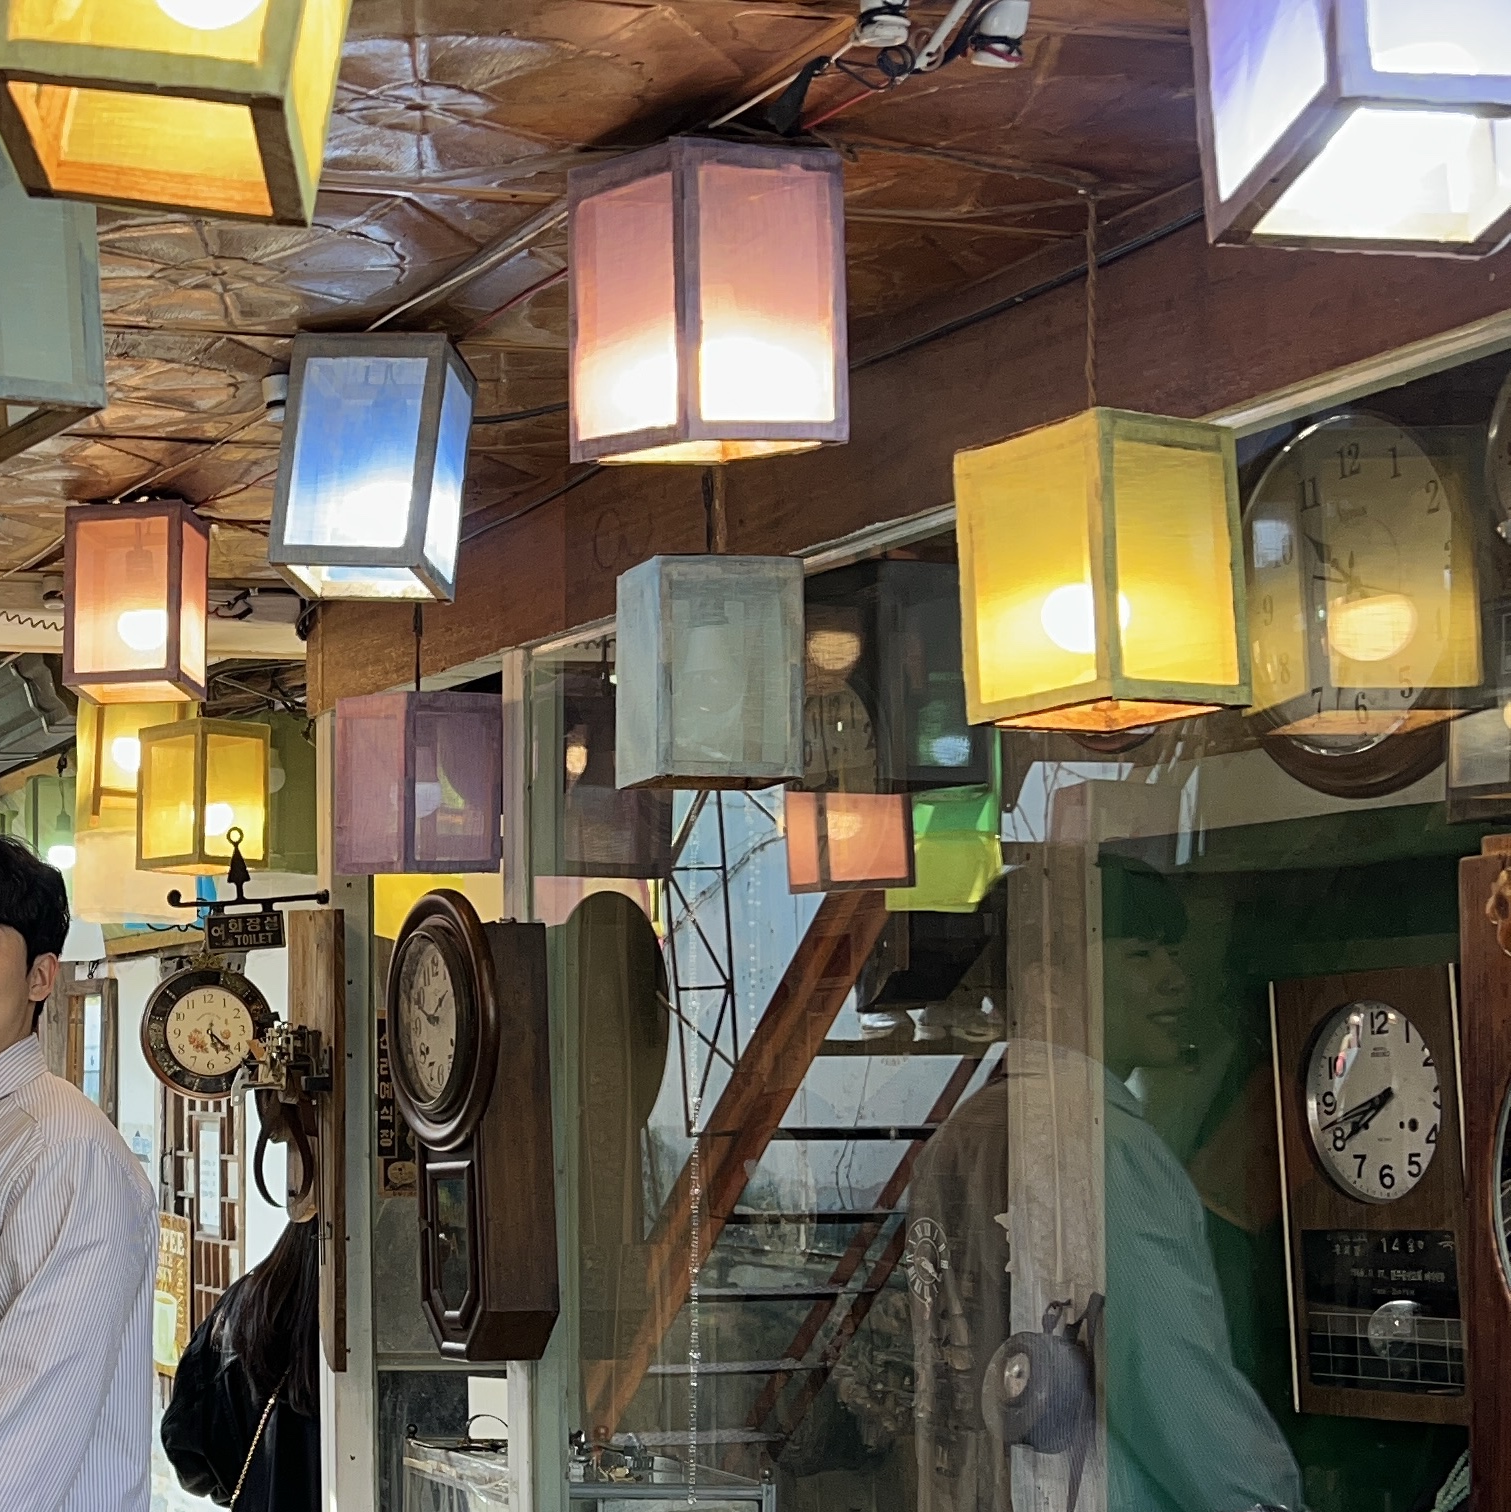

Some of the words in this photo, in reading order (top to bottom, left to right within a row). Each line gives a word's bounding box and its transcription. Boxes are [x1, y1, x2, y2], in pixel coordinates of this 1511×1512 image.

[1337, 442, 1361, 480] 12
[1389, 446, 1402, 479] 1
[1298, 476, 1321, 513] 11
[1425, 480, 1439, 515] 2
[1398, 665, 1414, 699] 5
[235, 933, 273, 946] TOILET
[186, 999, 195, 1009] 11
[203, 994, 214, 1004] 12
[222, 998, 226, 1008] 1
[175, 1012, 185, 1021] 10
[233, 1008, 241, 1019] 2
[1370, 1011, 1389, 1035] 12
[173, 1028, 181, 1038] 9
[239, 1025, 246, 1035] 3
[1405, 1020, 1410, 1043] 1
[178, 1044, 185, 1054] 8
[234, 1042, 241, 1052] 4
[190, 1056, 197, 1066] 7
[207, 1060, 214, 1070] 6
[224, 1054, 231, 1064] 5
[1328, 1055, 1345, 1080] 10
[1322, 1091, 1337, 1115] 9
[1333, 1127, 1346, 1151] 8
[1425, 1123, 1438, 1144] 4
[1353, 1154, 1367, 1179] 7
[1407, 1153, 1422, 1178] 5
[1379, 1164, 1395, 1189] 6
